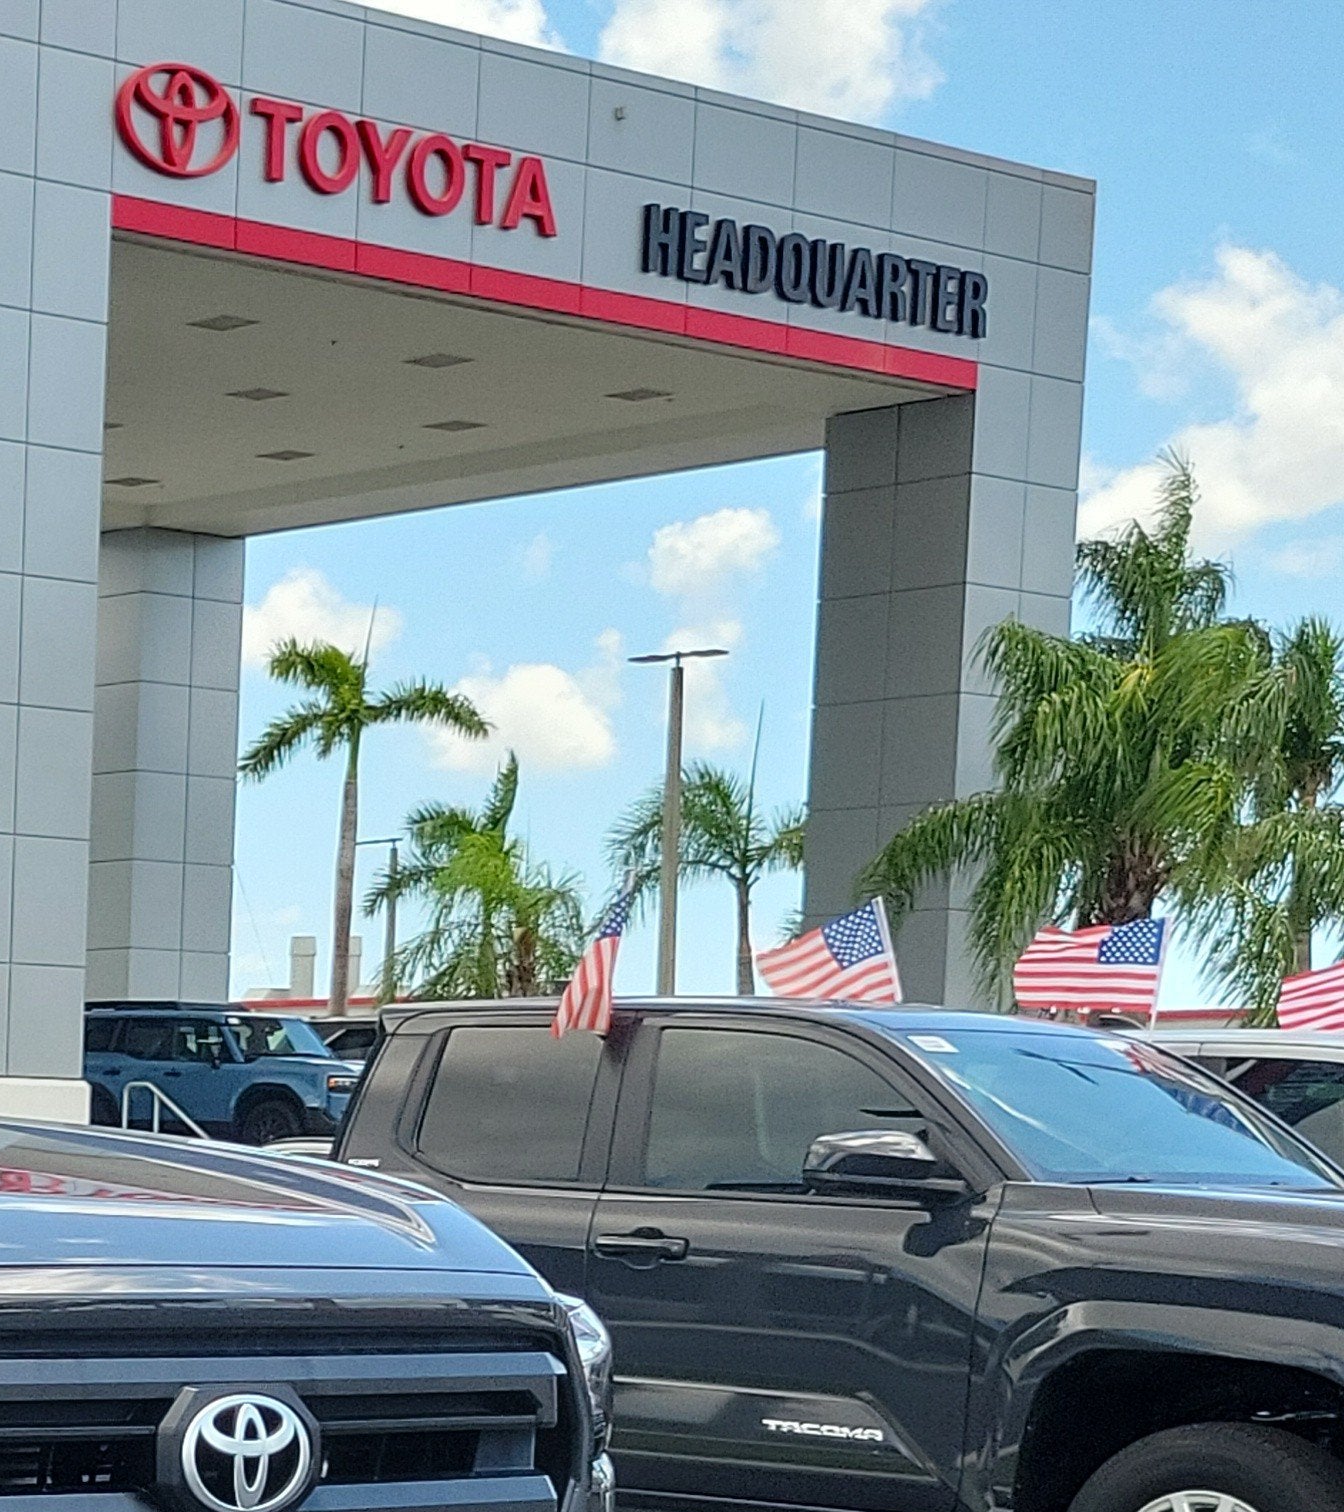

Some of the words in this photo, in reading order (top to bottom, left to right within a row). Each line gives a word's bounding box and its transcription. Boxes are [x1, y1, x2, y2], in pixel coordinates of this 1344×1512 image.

[250, 97, 557, 238] TOYOTA
[641, 203, 989, 338] HEADQUARTER
[762, 1418, 884, 1442] TACOMA
